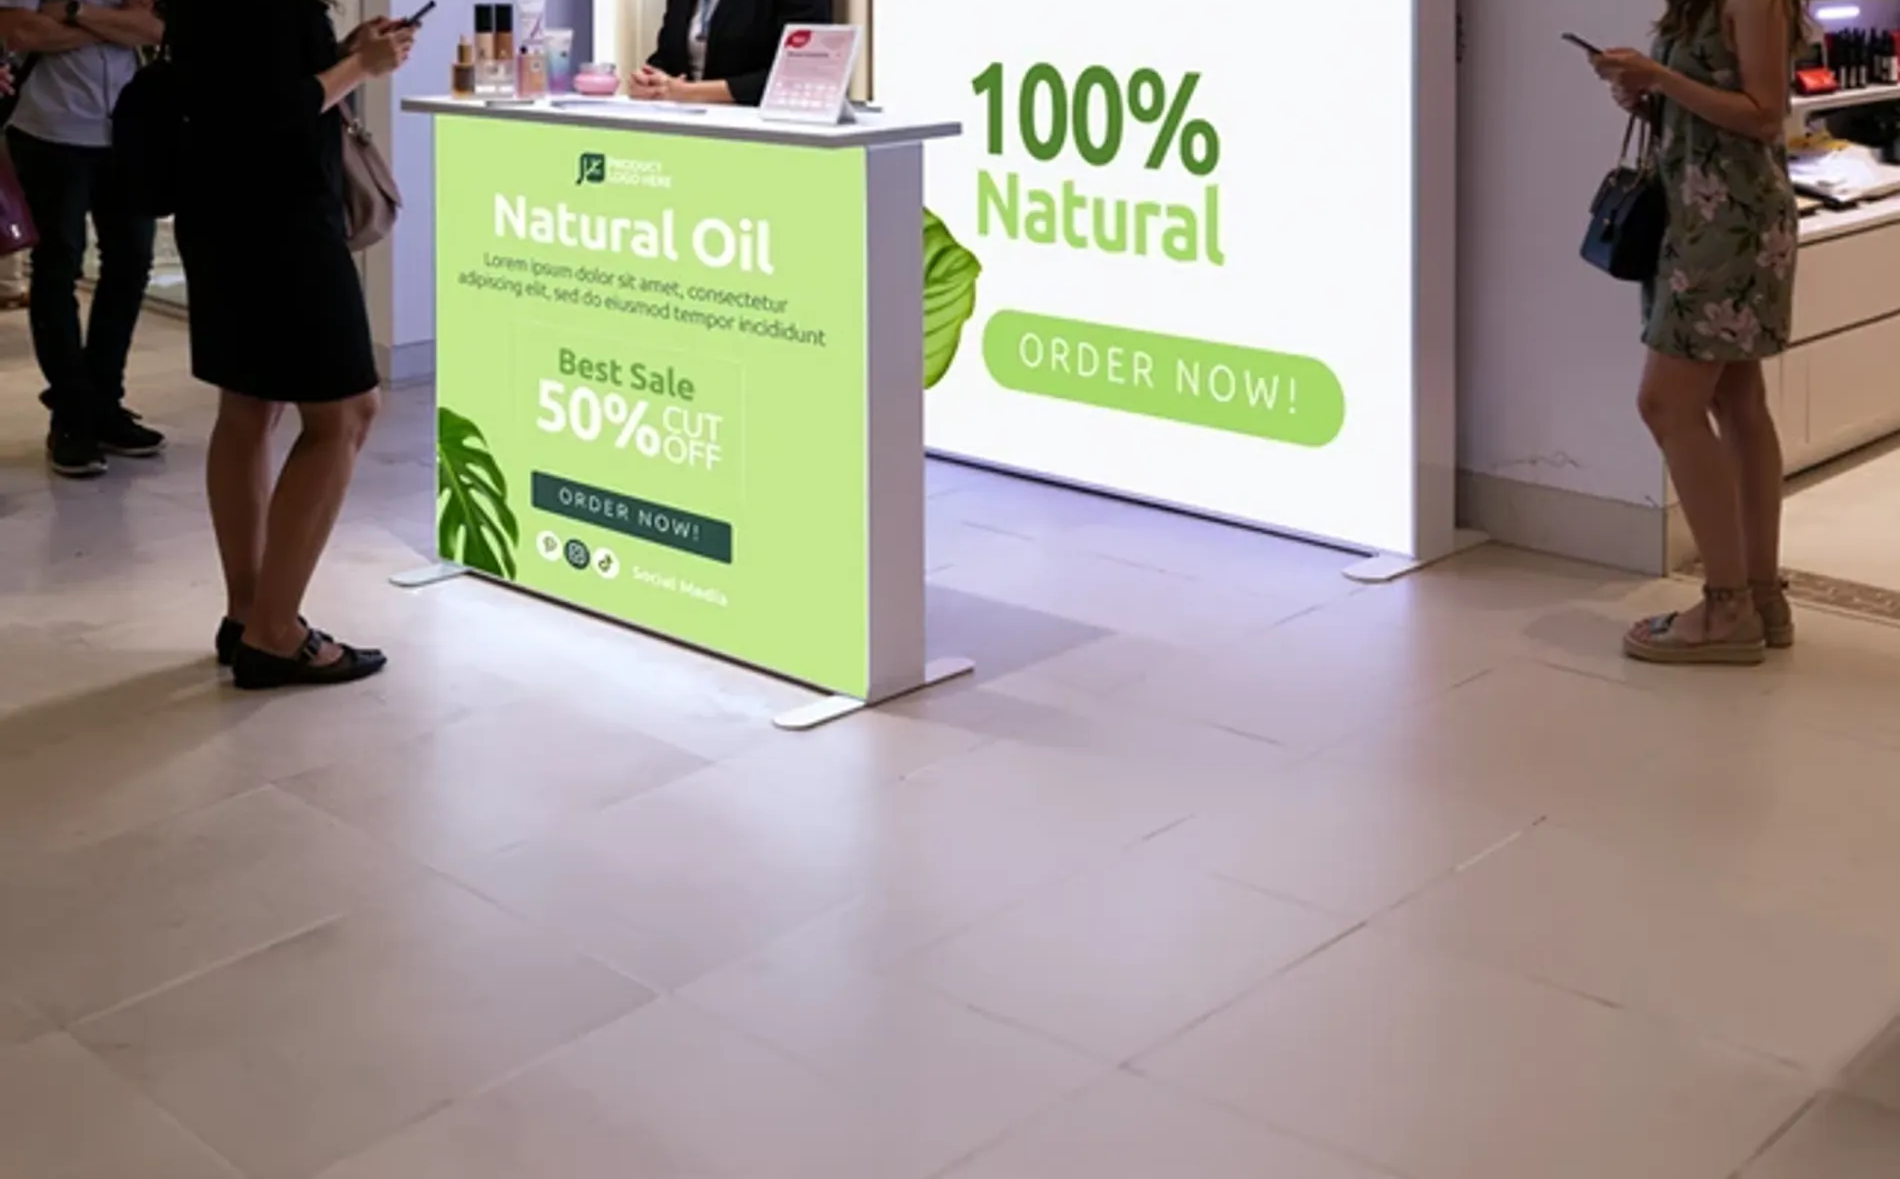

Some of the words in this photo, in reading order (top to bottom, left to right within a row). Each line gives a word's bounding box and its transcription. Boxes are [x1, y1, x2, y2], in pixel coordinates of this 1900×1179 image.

[971, 62, 1221, 176] 100%
[493, 192, 679, 261] Natural
[691, 217, 775, 275] Oil
[976, 168, 1225, 267] Natural
[458, 270, 522, 298] adipiscing
[526, 279, 550, 300] elit,
[554, 285, 579, 303] sed
[583, 289, 601, 308] do
[604, 293, 670, 320] eiusmod
[674, 306, 735, 331] tempor
[738, 315, 826, 347] incididunt
[483, 252, 527, 272] Lorem
[531, 260, 572, 282] ipsum
[575, 266, 615, 286] dolor
[618, 270, 635, 291] sit
[639, 277, 684, 300] amet,
[688, 284, 788, 314] consectetur
[558, 348, 622, 386] Best
[630, 362, 695, 401] Sale
[1018, 332, 1154, 389] ORDER
[1176, 358, 1299, 415] NOW!
[536, 378, 661, 457] 50%
[662, 405, 723, 442] CUT
[663, 435, 722, 470] OFF
[558, 487, 629, 520] ORDER
[638, 509, 700, 542] NOW!
[632, 566, 676, 591] Social
[680, 580, 728, 606] Media
